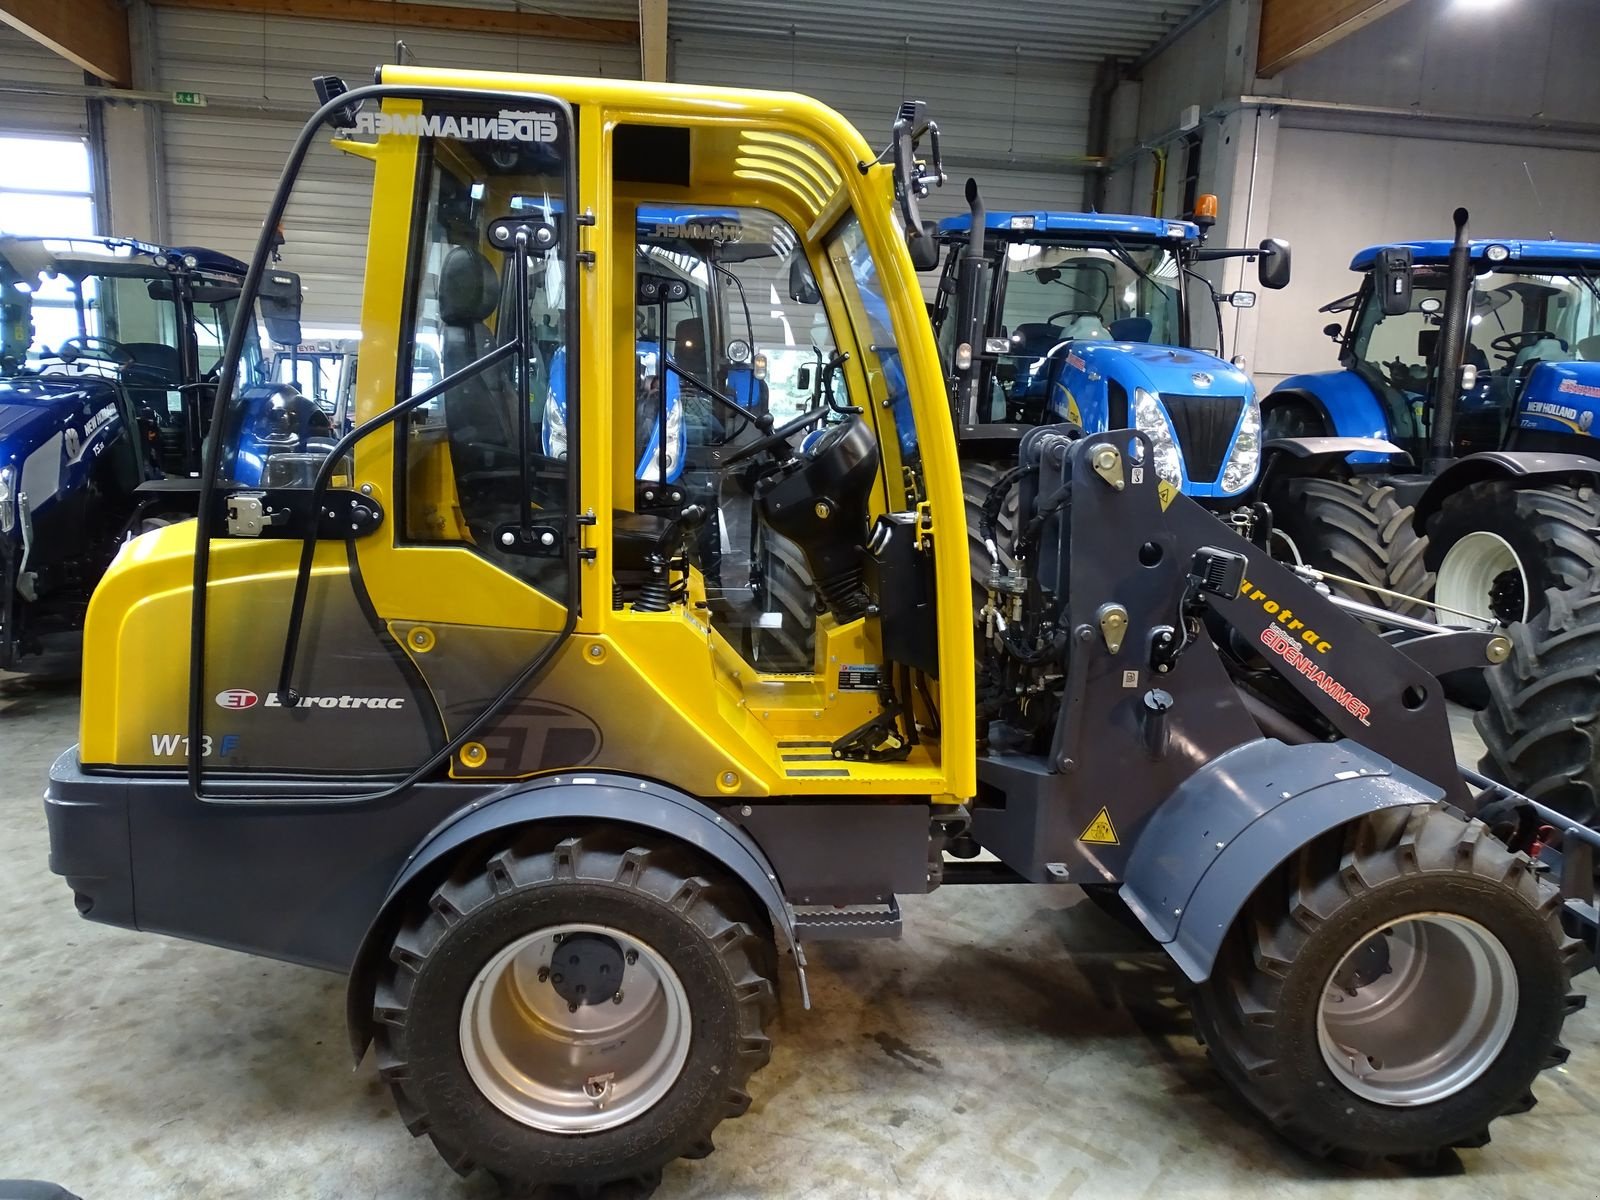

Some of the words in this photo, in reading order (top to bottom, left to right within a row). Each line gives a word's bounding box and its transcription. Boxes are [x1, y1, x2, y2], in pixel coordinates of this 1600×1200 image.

[1527, 401, 1544, 412] NEW
[1542, 403, 1577, 420] HOLLAND
[1239, 578, 1333, 654] urotrac
[1260, 628, 1370, 722] EIDENHAMMER
[223, 692, 253, 707] ET
[219, 733, 241, 758] F
